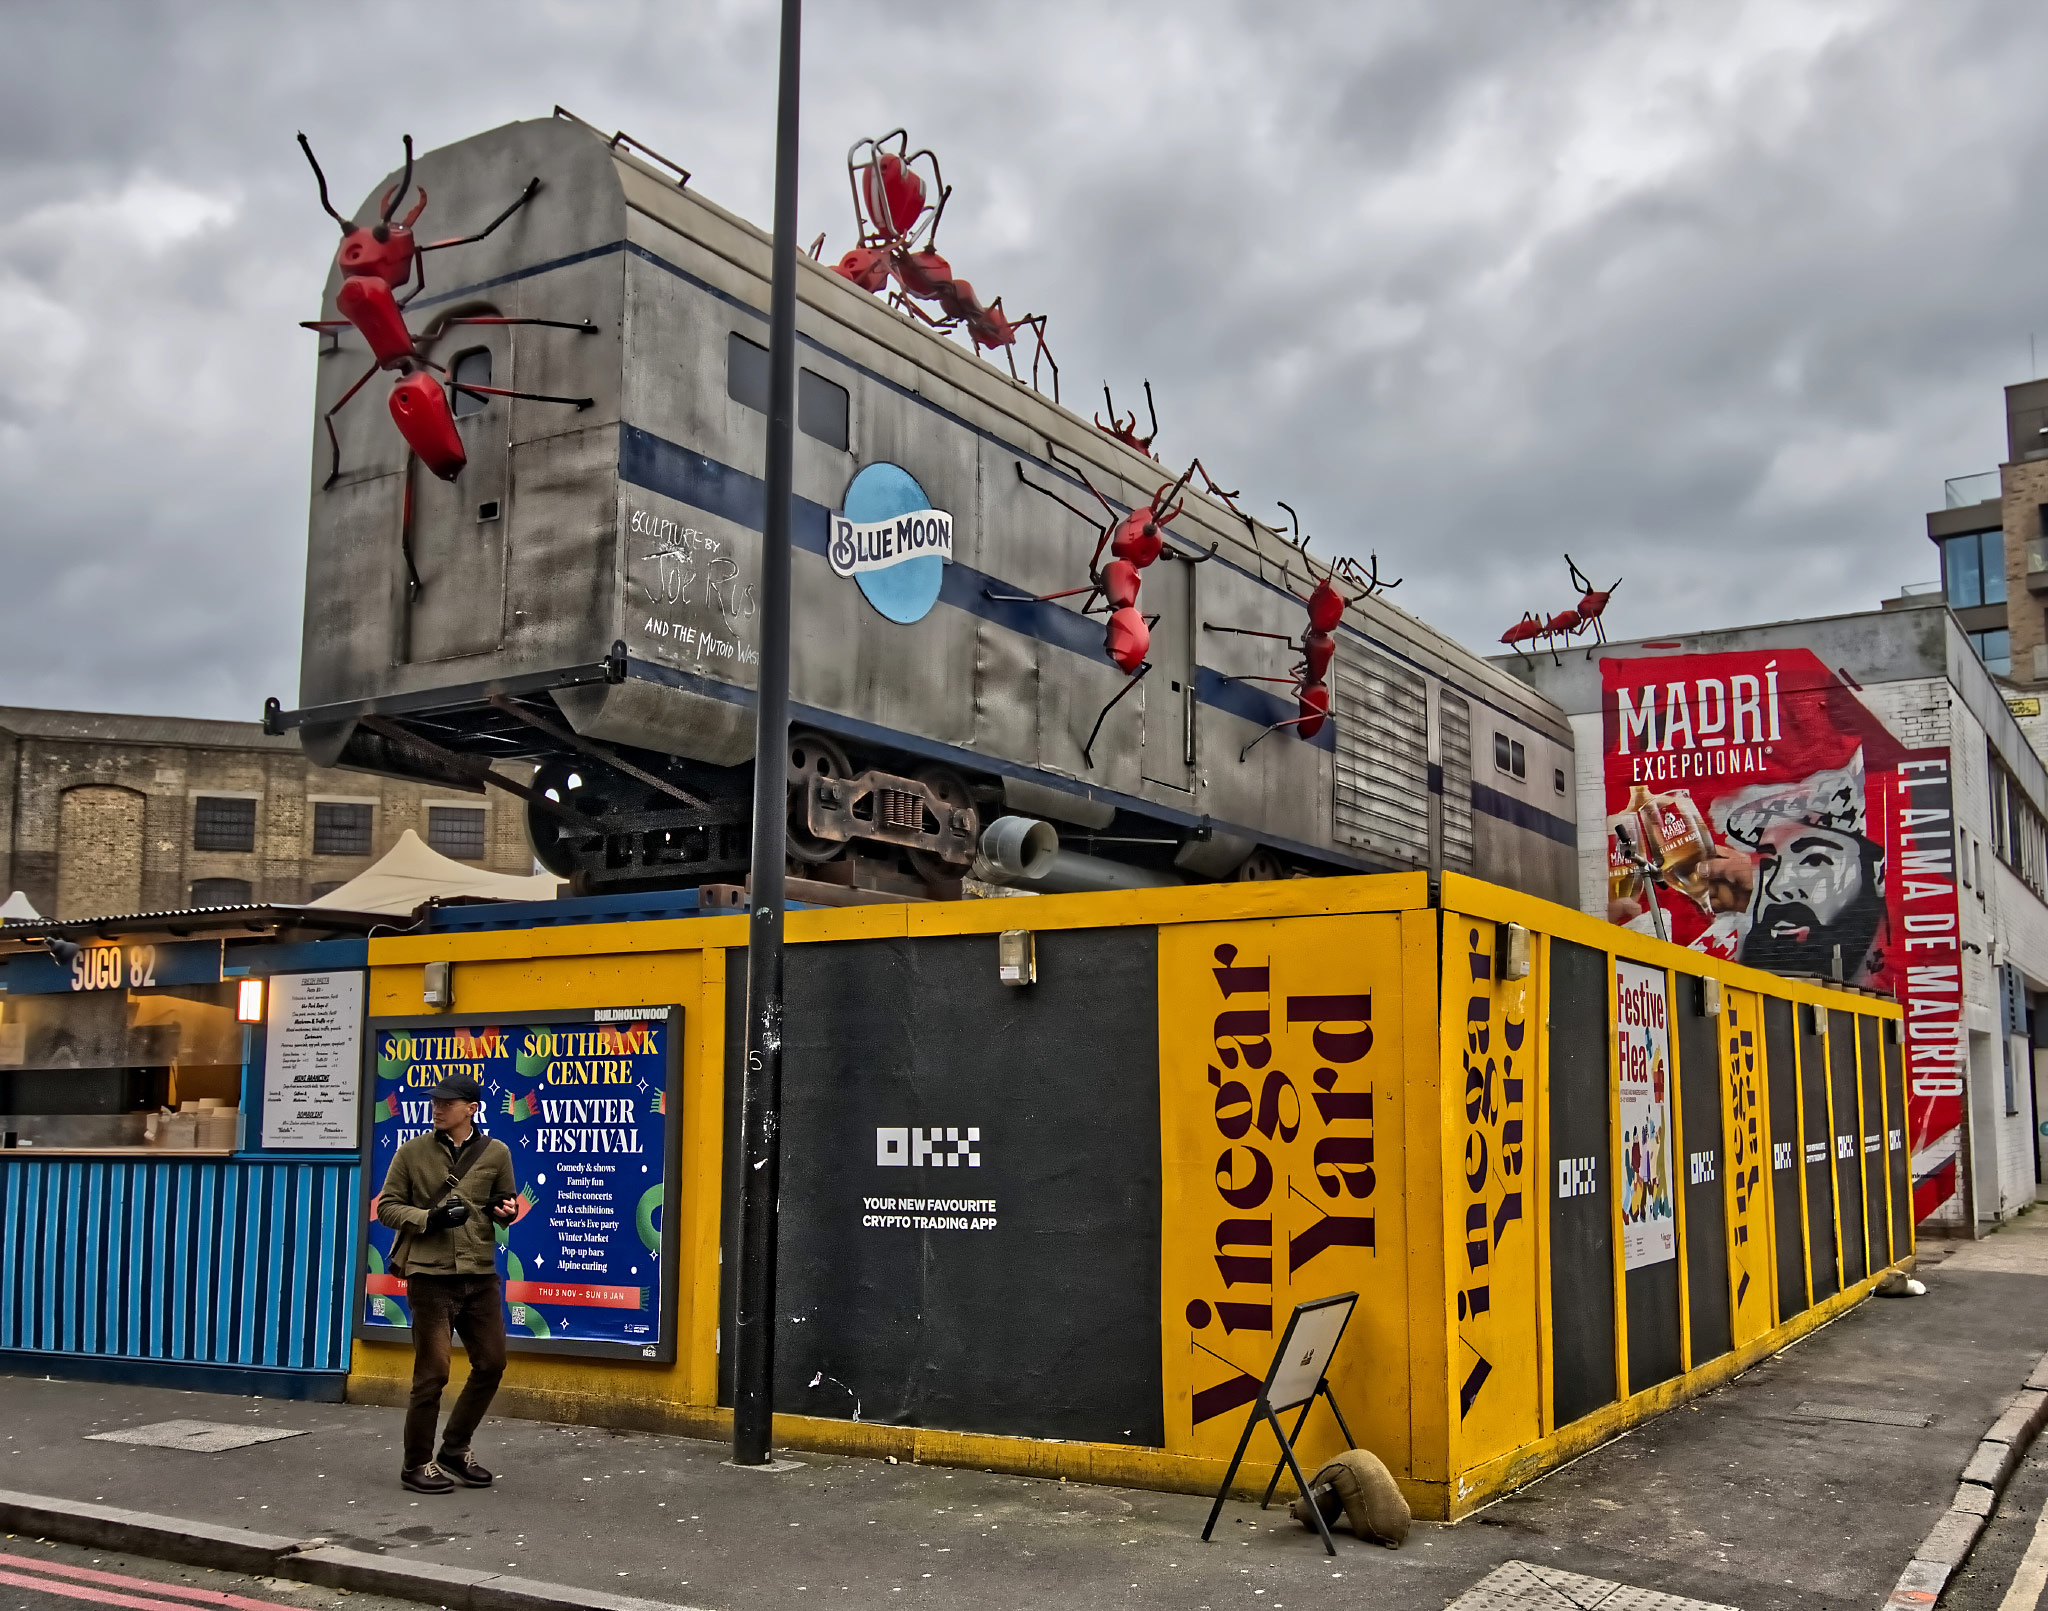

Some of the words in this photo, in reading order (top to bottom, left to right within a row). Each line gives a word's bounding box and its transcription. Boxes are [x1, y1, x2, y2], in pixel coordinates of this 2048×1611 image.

[632, 511, 703, 549] SCULPTURE
[705, 538, 720, 552] BY
[833, 521, 892, 570] BLUE
[897, 517, 949, 553] MOON
[705, 557, 760, 638] RUS
[645, 617, 668, 636] AND
[672, 624, 696, 643] THE
[1616, 659, 1782, 755] MADRÍ
[1898, 759, 1948, 794] EL
[1900, 809, 1953, 901] ALMA
[1904, 913, 1957, 952] DE
[72, 947, 121, 991] SUGO
[130, 945, 156, 988] 82
[1617, 973, 1664, 1029] Festive
[1907, 965, 1964, 1097] MADRID
[385, 1035, 510, 1061] SOUTHBANK
[524, 1031, 659, 1058] SOUTHBANK
[1619, 1031, 1648, 1083] Flea
[547, 1060, 633, 1085] CENTRE
[749, 1050, 763, 1070] 5
[401, 1100, 488, 1124] WIR
[541, 1099, 636, 1124] WINTER
[536, 1128, 644, 1153] FESTIVAL
[877, 1127, 980, 1167] OKX
[1287, 986, 1376, 1285] Yard
[557, 1162, 586, 1174] Comedy
[586, 1163, 592, 1172] &
[593, 1163, 616, 1172] shows
[1690, 1150, 1715, 1185] OKX
[1774, 1142, 1792, 1170] OKX
[567, 1176, 591, 1188] Family
[591, 1177, 604, 1186] fun
[1186, 943, 1300, 1436] Vinegar
[1458, 928, 1498, 1433] Vinegar
[1558, 1156, 1596, 1198] OKX
[558, 1190, 582, 1200] Festive
[582, 1191, 613, 1200] concerts
[863, 1197, 896, 1210] YOUR
[898, 1198, 925, 1211] NEW
[927, 1199, 997, 1212] FAVOURITE
[555, 1204, 567, 1213] Art
[567, 1204, 574, 1213] &
[575, 1205, 614, 1214] exhibitions
[549, 1218, 565, 1227] New
[587, 1219, 599, 1228] Eve
[600, 1220, 619, 1231] party
[862, 1215, 911, 1228] CRYPTO
[913, 1216, 968, 1230] TRADING
[970, 1217, 997, 1230] APP
[558, 1232, 583, 1241] Winter
[584, 1232, 609, 1242] Market
[561, 1246, 587, 1258] Pop-up
[588, 1247, 604, 1256] bars
[557, 1260, 581, 1271] Alpine
[581, 1261, 608, 1273] curling
[397, 1280, 407, 1288] TH
[539, 1288, 553, 1296] THU
[555, 1288, 560, 1296] 3
[562, 1289, 576, 1297] NOV
[585, 1291, 600, 1299] SUN
[610, 1292, 624, 1300] JAN
